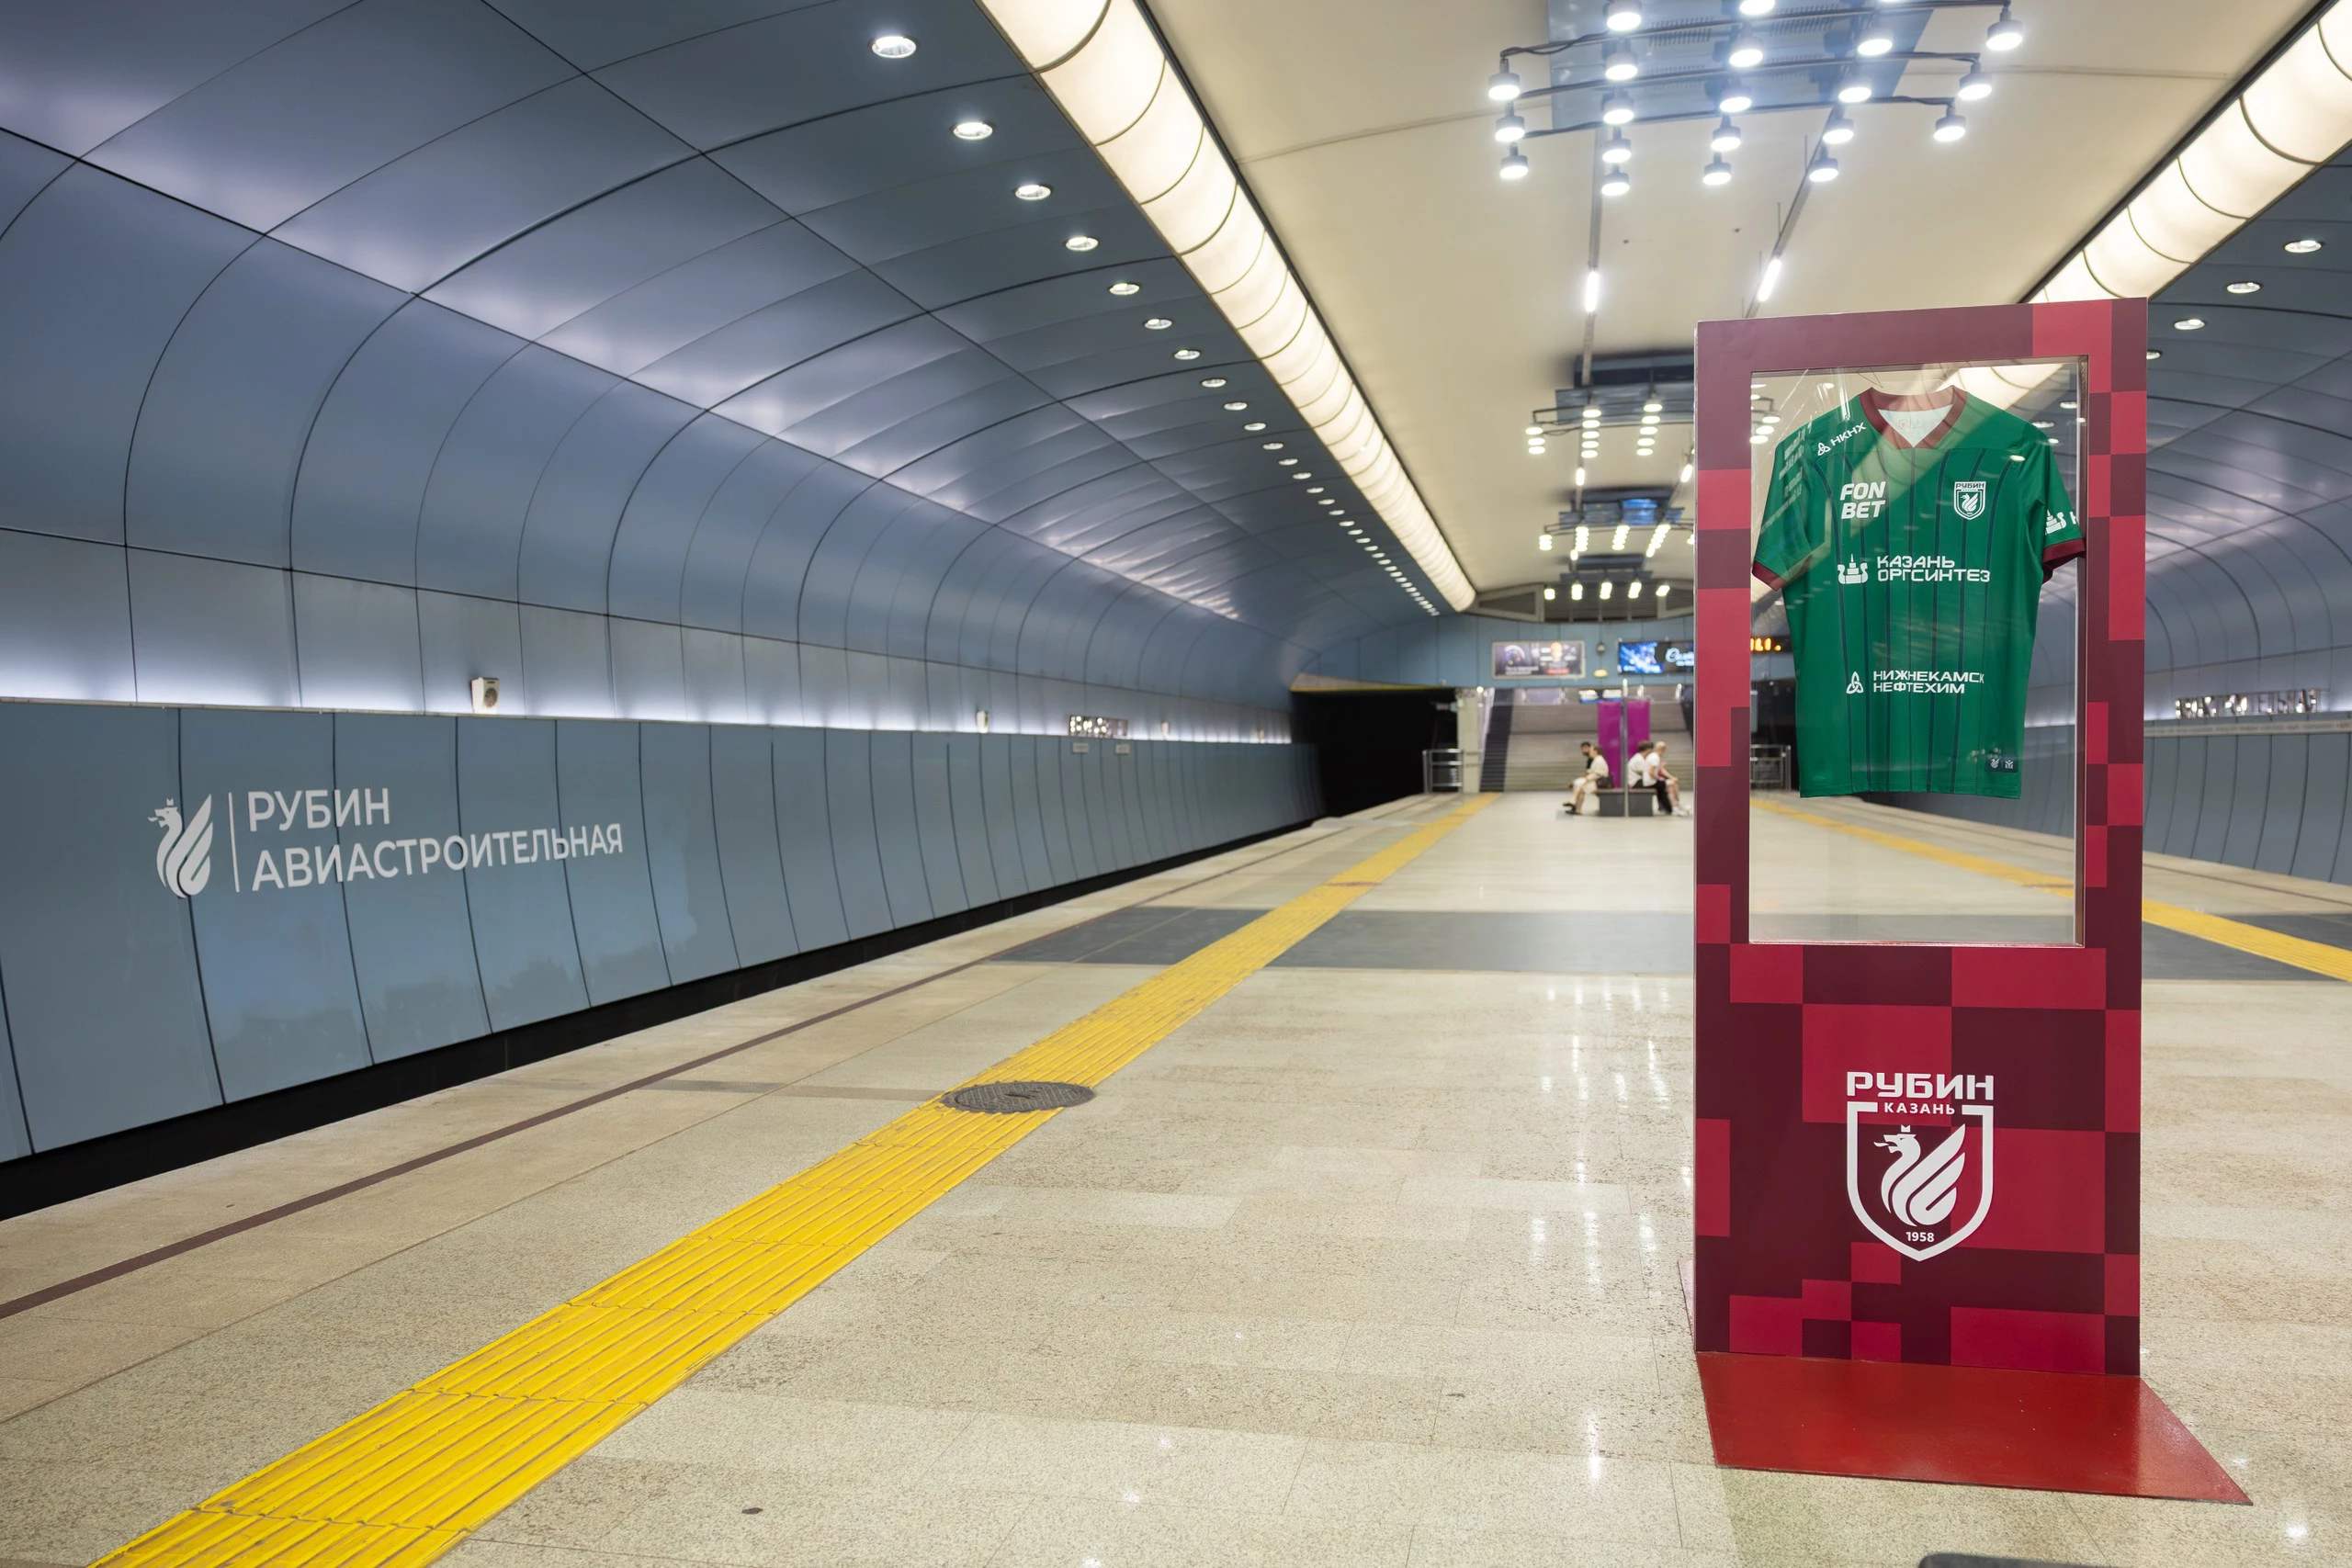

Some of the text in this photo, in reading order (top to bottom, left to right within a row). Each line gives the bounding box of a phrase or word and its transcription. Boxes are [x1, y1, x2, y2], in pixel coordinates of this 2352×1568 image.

[1830, 422, 1867, 446] НКНХ
[1840, 481, 1886, 501] FON
[1841, 500, 1886, 519] BET
[1877, 555, 1955, 569] КАЗАНЬ
[1877, 569, 1990, 582] ОРГСИНТЕЗ
[1873, 670, 1984, 683] НИЖНЕКАМСК
[1873, 682, 1965, 694] НЕФТЕХИМ
[248, 788, 390, 832] РУБИН
[252, 823, 624, 891] АВИАСТРОИТЕЛЬНАЯ
[1847, 1071, 1994, 1100] РУБИН
[1884, 1102, 1956, 1115] КАЗАНЬ
[1905, 1231, 1935, 1242] 1958
